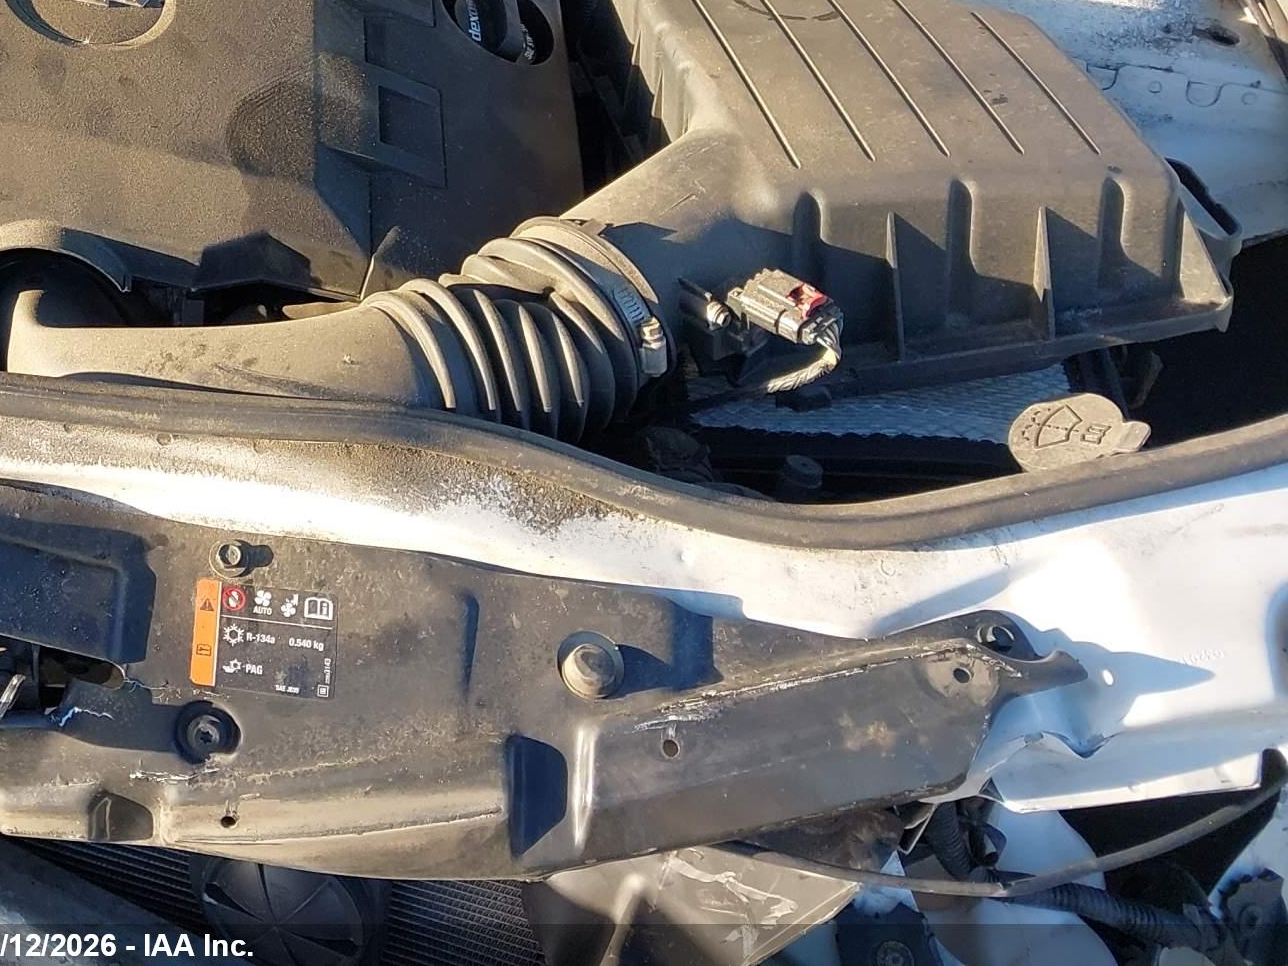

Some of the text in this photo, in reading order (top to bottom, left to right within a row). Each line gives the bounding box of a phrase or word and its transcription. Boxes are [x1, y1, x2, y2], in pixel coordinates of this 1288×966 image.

[253, 605, 273, 616] AUTO
[247, 632, 324, 651] R-134a 0.540 kg
[245, 663, 263, 675] PAG
